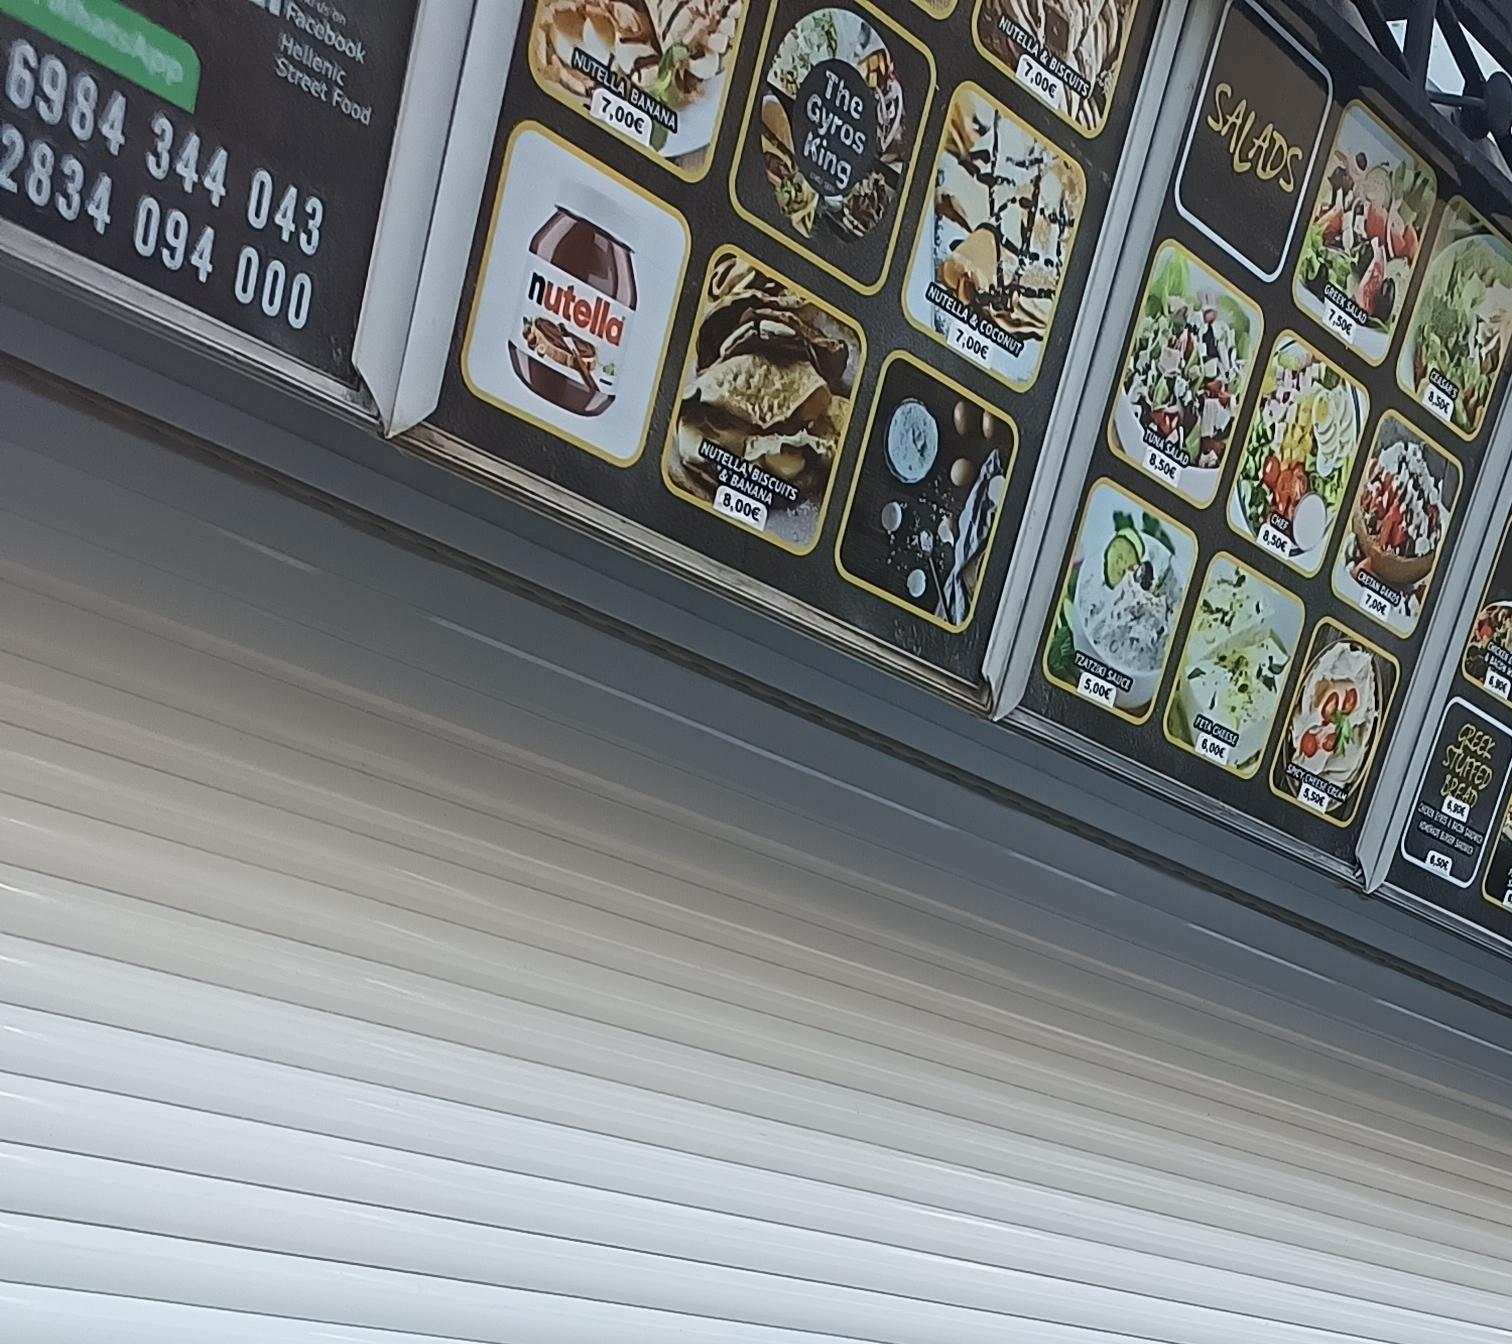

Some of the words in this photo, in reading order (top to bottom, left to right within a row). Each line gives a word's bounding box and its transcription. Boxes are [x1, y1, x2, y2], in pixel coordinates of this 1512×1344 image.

[286, 1, 366, 64] Facebook
[280, 32, 347, 87] Hellenic
[999, 15, 1039, 57] NUTELLA
[1040, 50, 1049, 65] &
[1049, 56, 1090, 97] BISCUITS
[273, 54, 328, 102] Street
[332, 86, 372, 126] Food
[574, 50, 627, 97] NUTELLA
[630, 89, 676, 131] BANANA
[825, 70, 863, 120] The
[1024, 61, 1057, 99] 7,00€
[600, 95, 645, 135] 7,00€
[806, 93, 866, 154] Gyros
[6, 38, 127, 156] 6984
[146, 110, 228, 208] 344
[247, 168, 324, 256] 043
[1207, 82, 1303, 193] SALADS
[803, 131, 852, 190] King
[0, 122, 112, 235] 2834
[134, 194, 215, 283] 094
[234, 246, 312, 329] 000
[528, 272, 625, 347] nutella
[928, 286, 969, 320] NUTELLA
[969, 313, 979, 328] &
[979, 319, 1023, 354] COCONUT
[1324, 284, 1348, 309] GREEK
[1345, 298, 1368, 324] SALAD
[1328, 309, 1352, 336] 7,50€
[956, 328, 989, 360] 7,00€
[1428, 391, 1450, 414] 8,50€
[1145, 431, 1166, 450] TUNA
[1165, 442, 1189, 466] SALAD
[1149, 453, 1176, 479] 8,50€
[700, 441, 748, 478] NUTELLA,
[751, 469, 798, 501] BISCUITS
[718, 468, 728, 483] &
[729, 474, 773, 505] BANANA
[722, 492, 760, 521] 8,00€
[1271, 513, 1289, 530] CHEF
[1262, 530, 1288, 552] 8,50€
[1357, 570, 1380, 591] CRETAN
[1364, 593, 1388, 615] 7,00€
[1083, 678, 1113, 700] 5,00€
[1105, 670, 1133, 691] SAUCE
[1201, 738, 1227, 758] 6,00€
[1211, 724, 1238, 746] CHEESE
[1458, 723, 1496, 760] GREEK
[1442, 744, 1493, 791] STUFFED
[1440, 774, 1479, 809] BREAD
